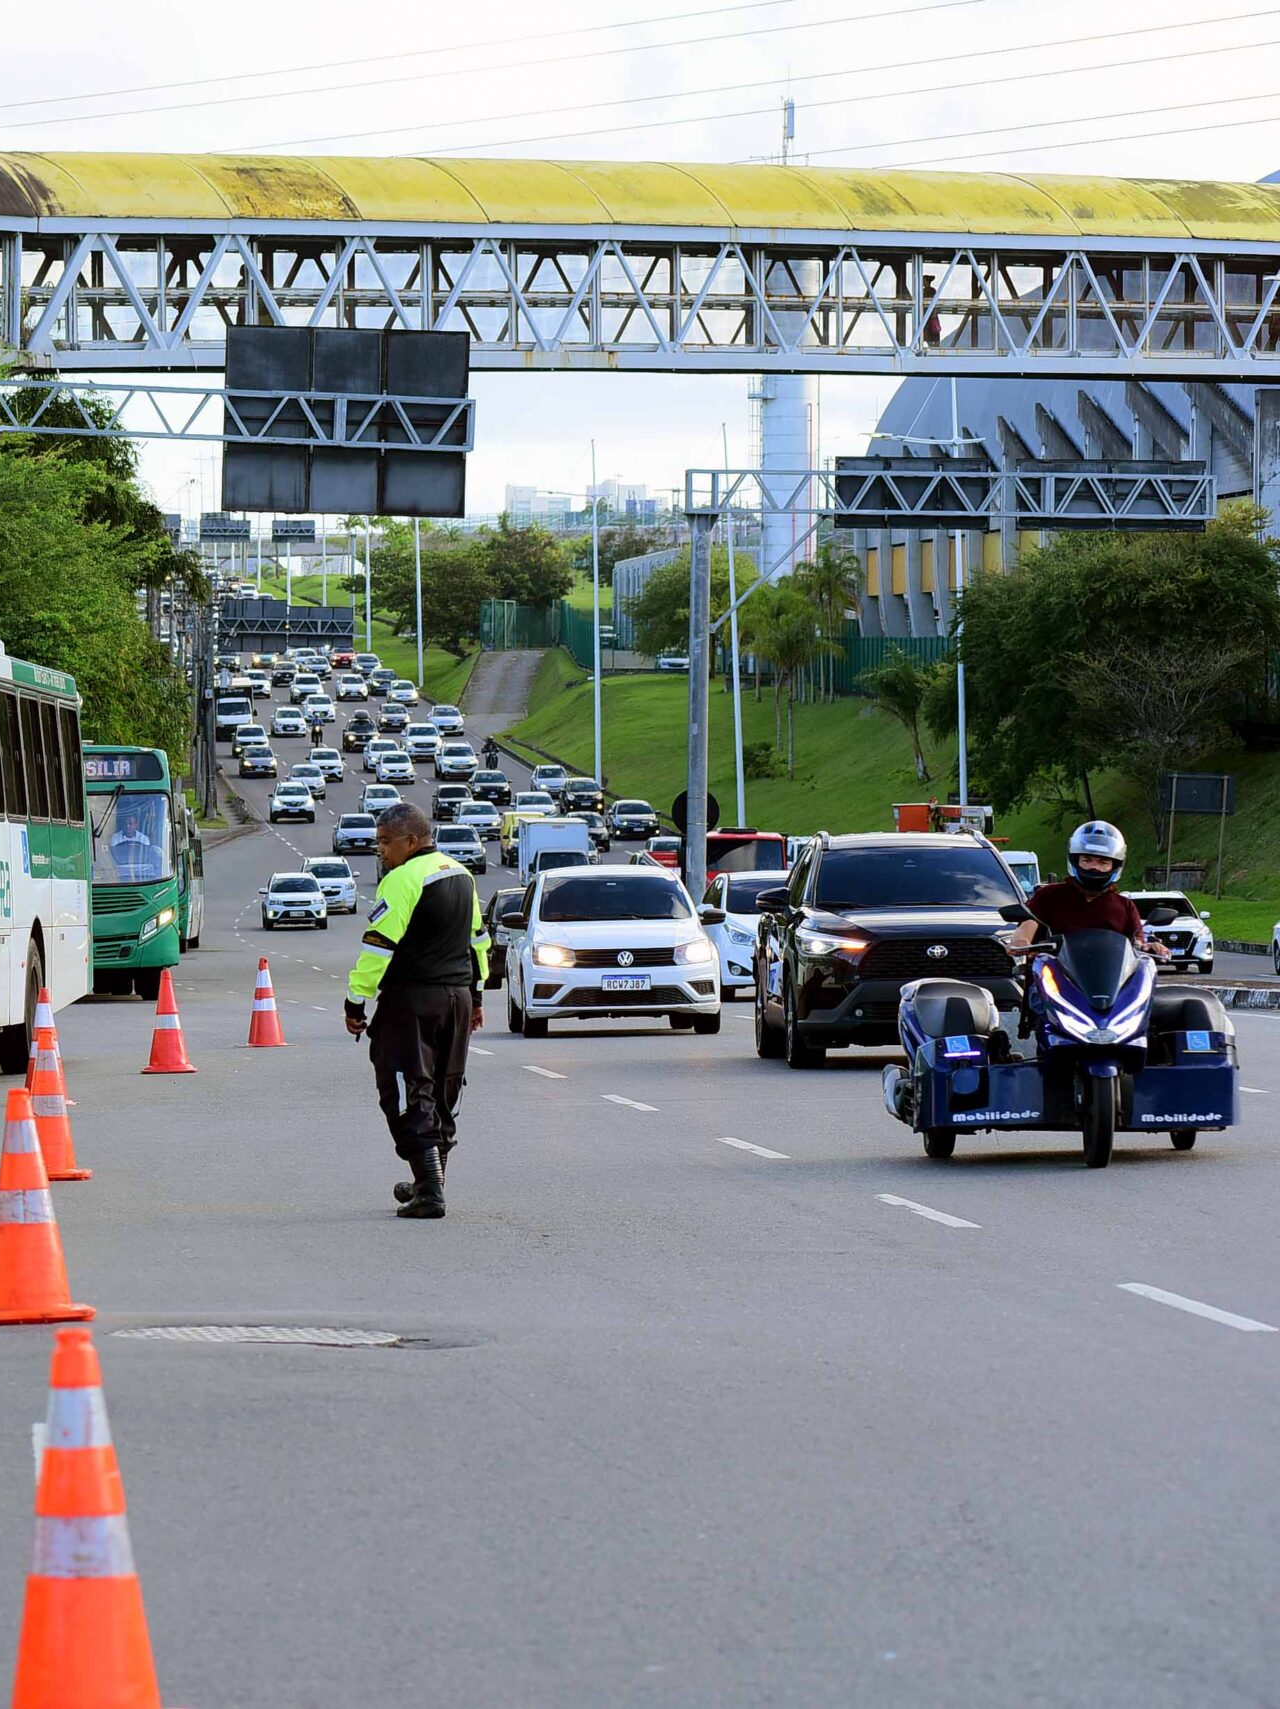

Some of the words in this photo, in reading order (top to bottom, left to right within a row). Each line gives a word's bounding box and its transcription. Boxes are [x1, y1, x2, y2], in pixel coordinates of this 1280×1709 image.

[84, 760, 130, 777] SILIA
[952, 1110, 1041, 1123] Mobilidade
[1141, 1113, 1222, 1123] Mobilidade
